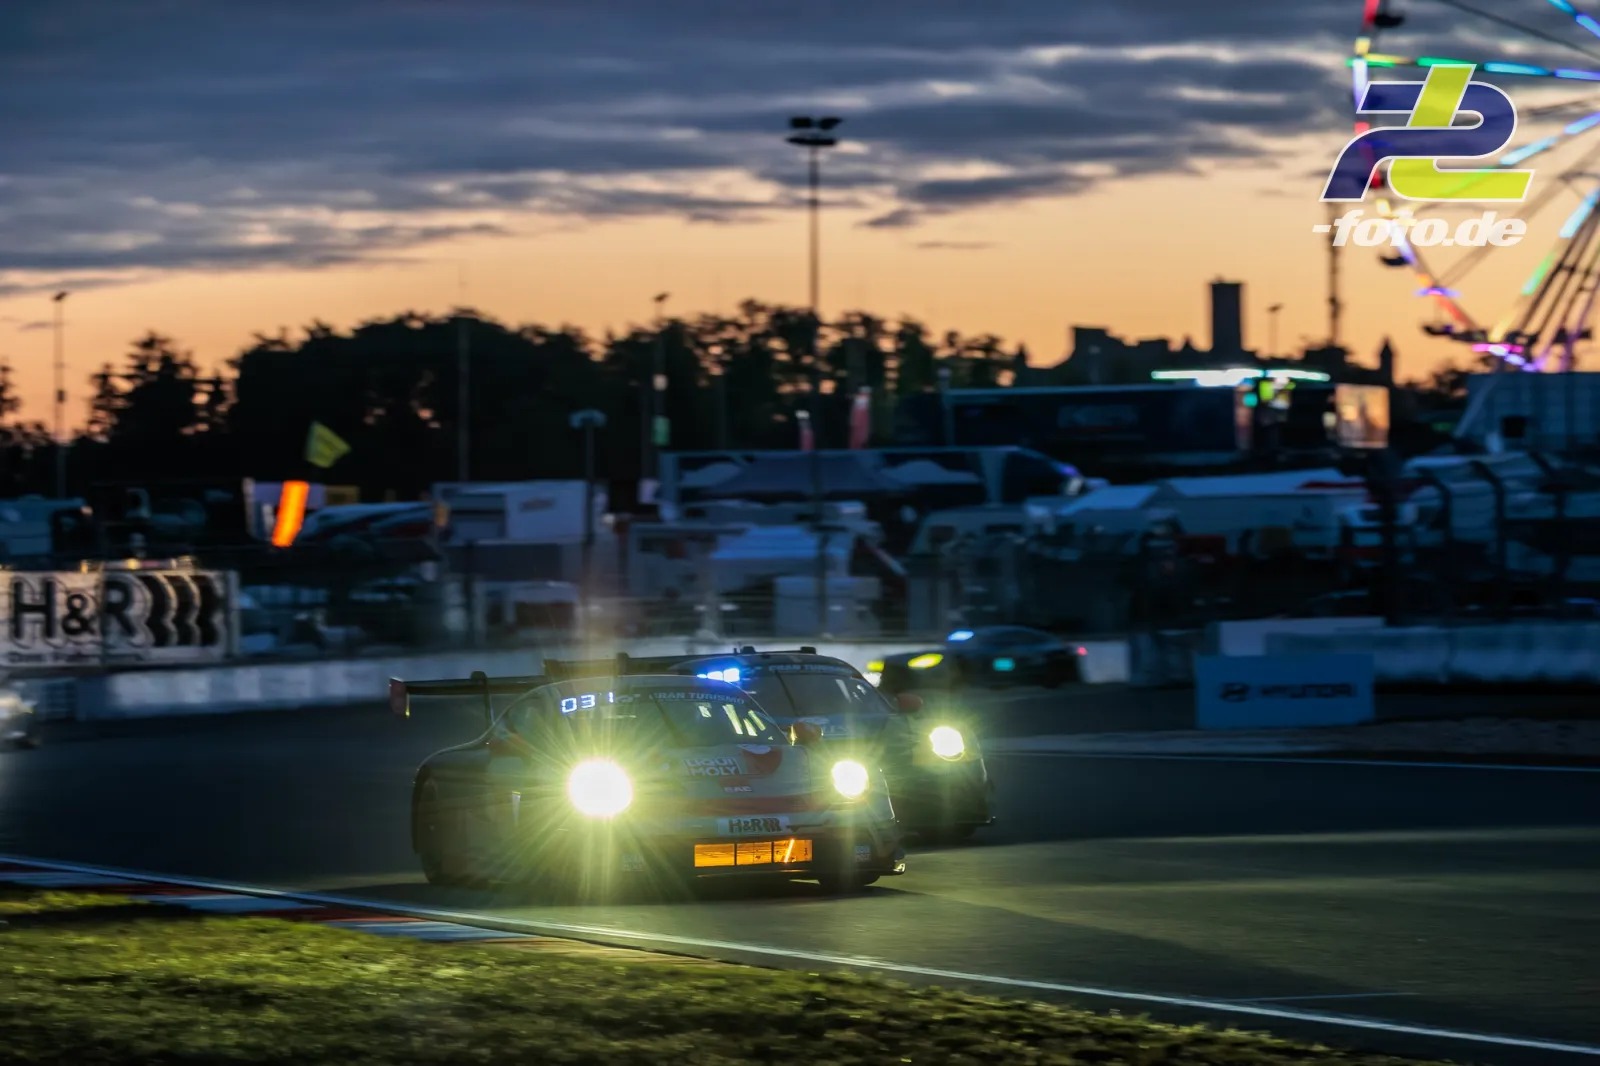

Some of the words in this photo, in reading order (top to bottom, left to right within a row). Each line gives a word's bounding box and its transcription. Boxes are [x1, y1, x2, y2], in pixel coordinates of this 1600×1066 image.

[12, 579, 137, 640] H&R
[688, 692, 746, 705] TURISMO
[687, 758, 735, 767] LIQUI
[690, 766, 738, 777] MOLY
